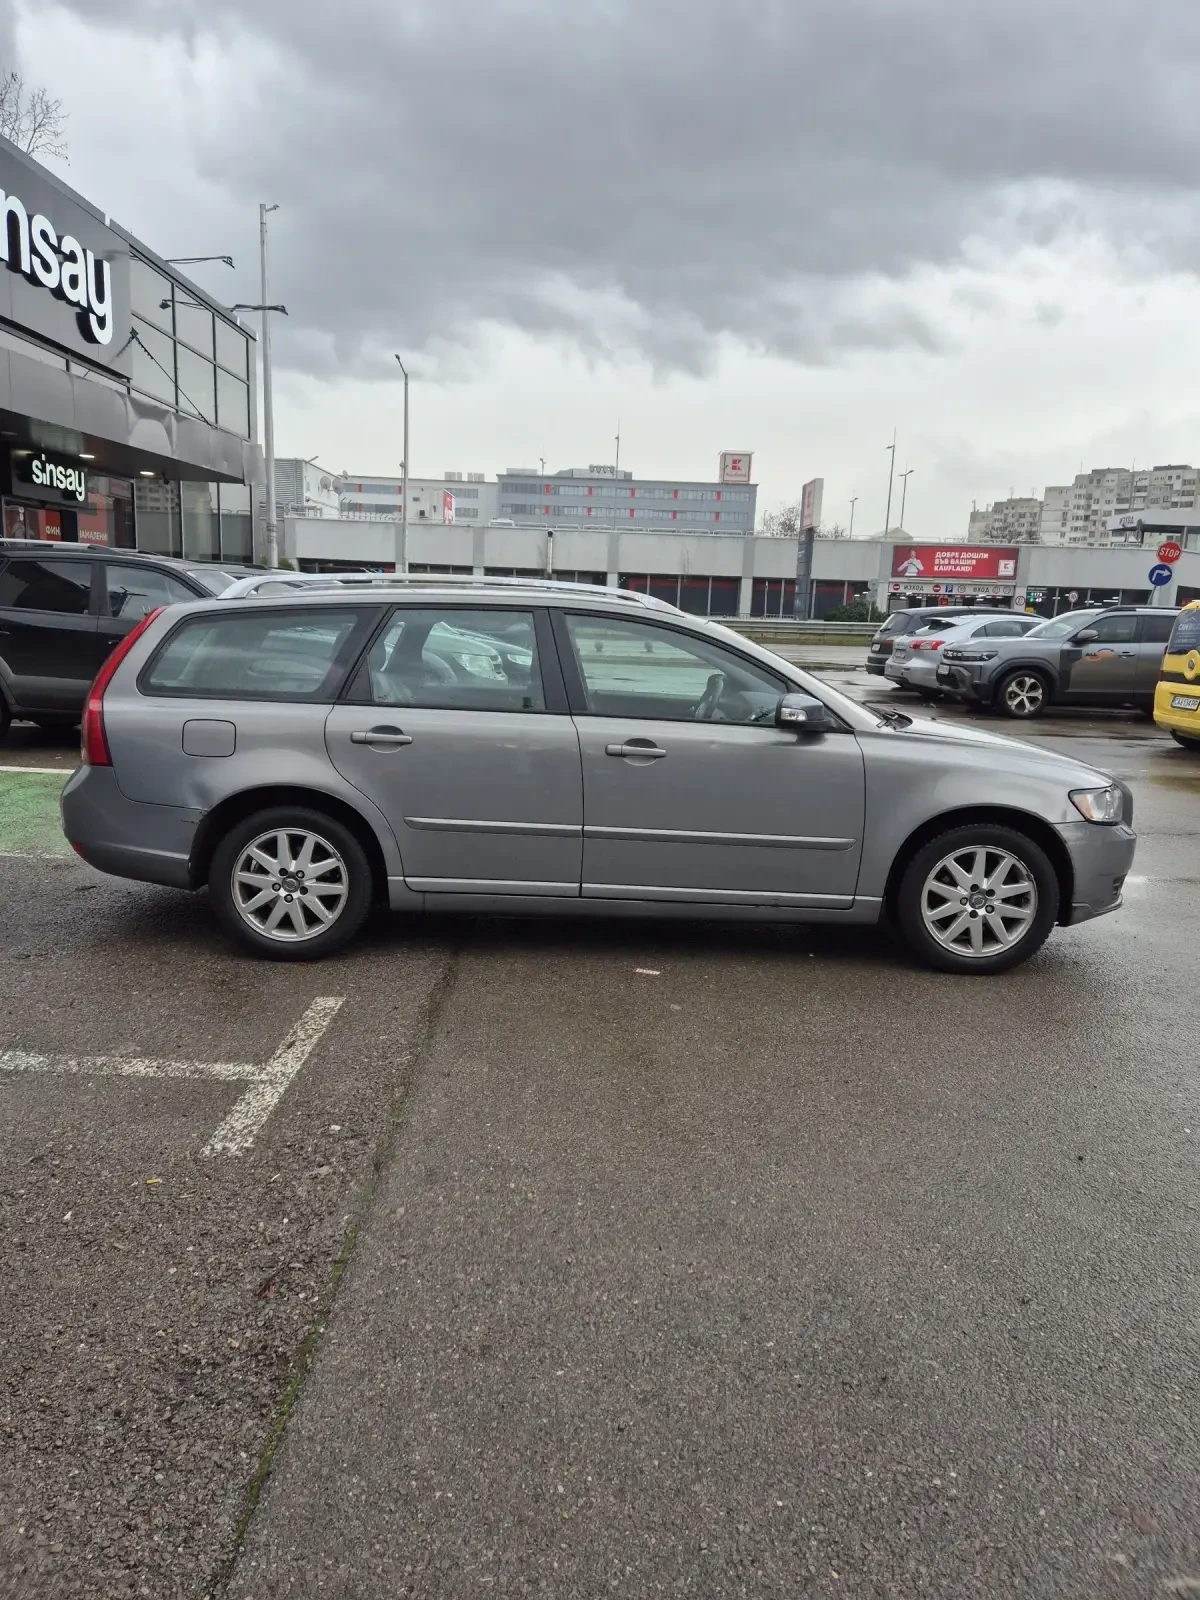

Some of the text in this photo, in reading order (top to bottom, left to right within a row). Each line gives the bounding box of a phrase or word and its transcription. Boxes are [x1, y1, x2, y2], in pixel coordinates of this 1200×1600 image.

[32, 453, 85, 502] sinsay
[935, 551, 989, 560] ДОБРЕ ДОШЛИ
[1159, 547, 1180, 558] STOP
